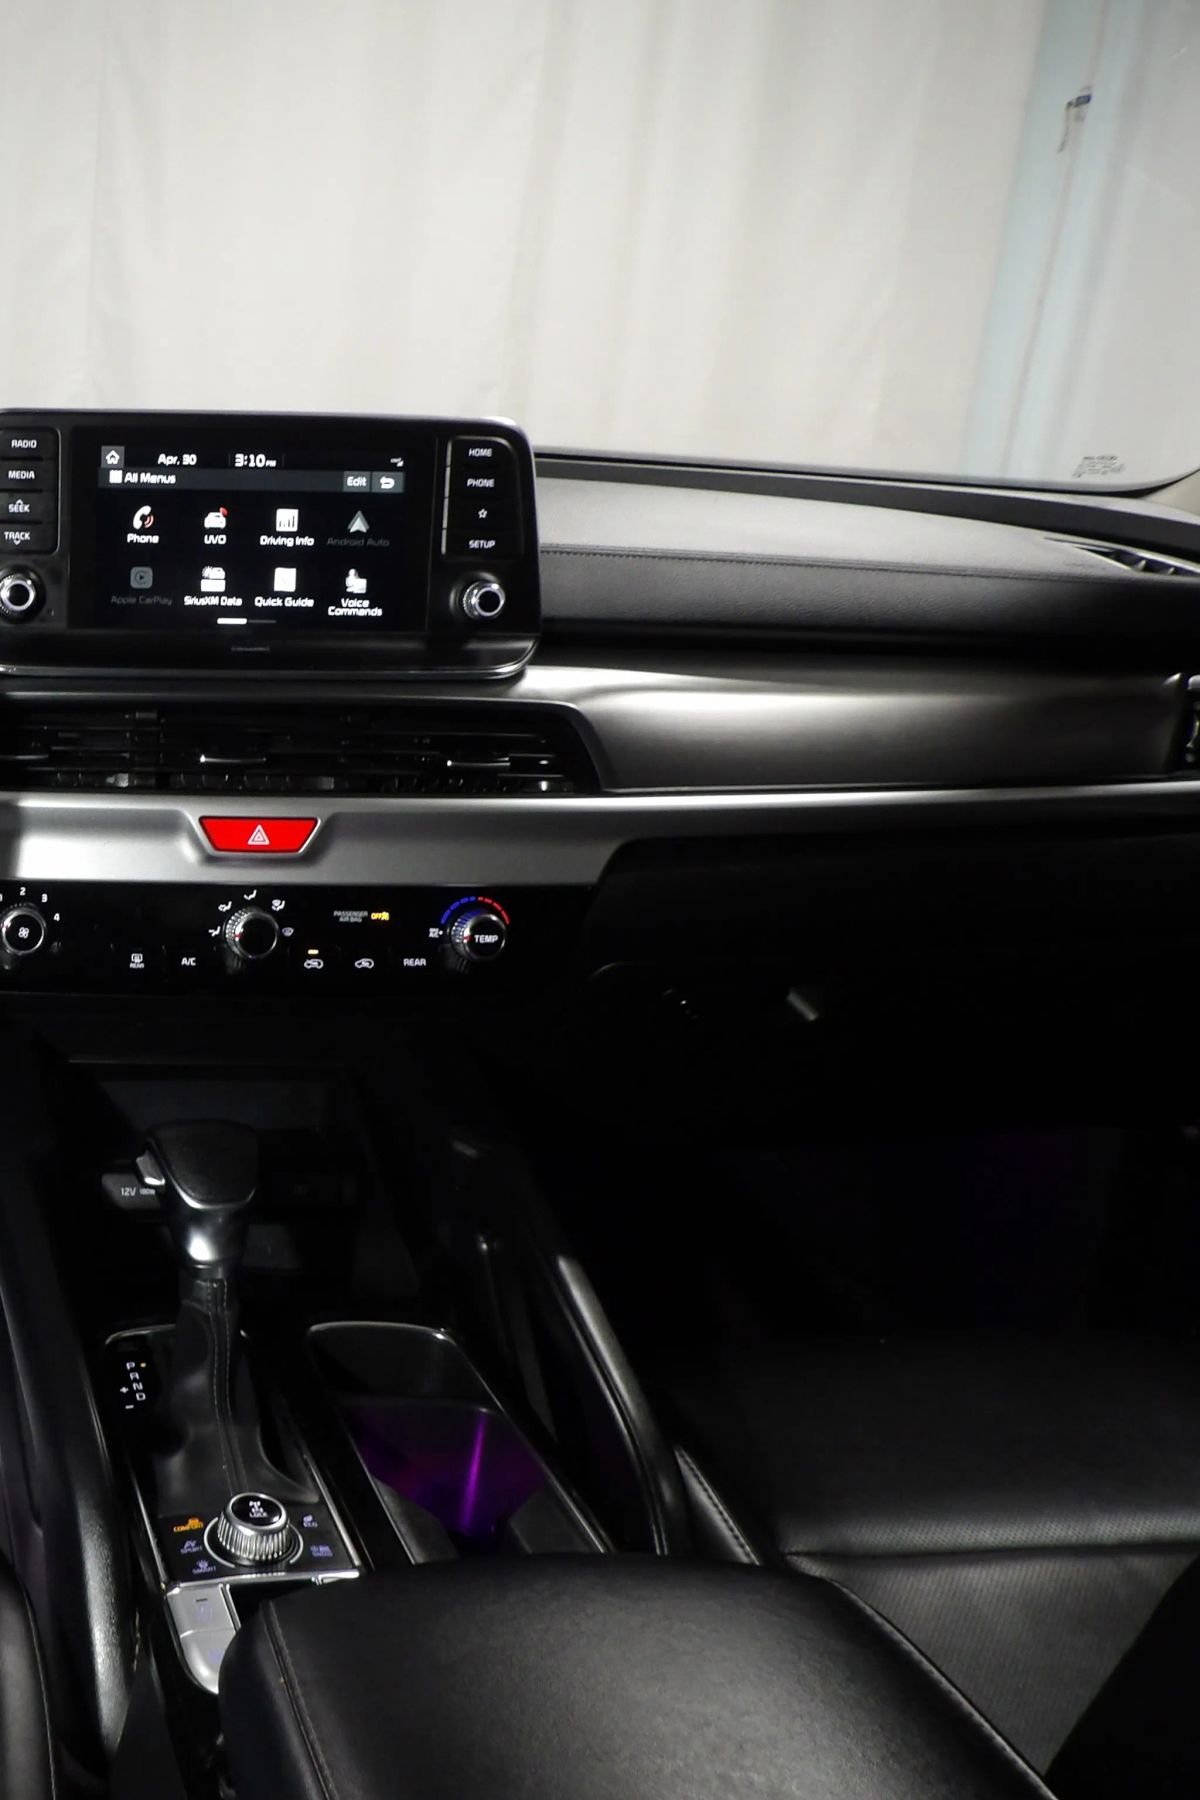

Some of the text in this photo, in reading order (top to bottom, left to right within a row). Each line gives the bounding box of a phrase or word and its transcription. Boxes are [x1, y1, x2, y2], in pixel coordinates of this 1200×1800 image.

[11, 439, 37, 448] RADIO
[468, 448, 492, 457] HOME
[182, 454, 197, 465] 30
[8, 470, 35, 479] MEDIA
[124, 472, 176, 484] All Menus
[346, 476, 367, 487] Edit
[467, 478, 495, 487] PHONE
[8, 503, 30, 513] SEEK
[4, 531, 30, 541] TRACK
[127, 533, 159, 544] Phone
[204, 535, 227, 544] UVO
[260, 535, 315, 547] Driving Info
[327, 537, 390, 547] Android Auto
[468, 540, 495, 549] SETUP
[184, 595, 243, 606] SiriusXM Data
[254, 596, 314, 607] Quick Guide
[341, 598, 369, 607] Voice
[328, 606, 382, 616] Commands
[19, 887, 26, 896] 2
[41, 893, 48, 903] 3
[53, 912, 60, 922] 4
[333, 910, 368, 918] PASSENGER
[371, 912, 382, 921] OFF
[474, 934, 498, 944] TEMP
[181, 957, 196, 966] A/C
[403, 958, 426, 967] REAR
[121, 1187, 137, 1197] 12V
[126, 1361, 135, 1370] P
[130, 1372, 140, 1380] R
[133, 1382, 143, 1391] N
[136, 1392, 146, 1401] D
